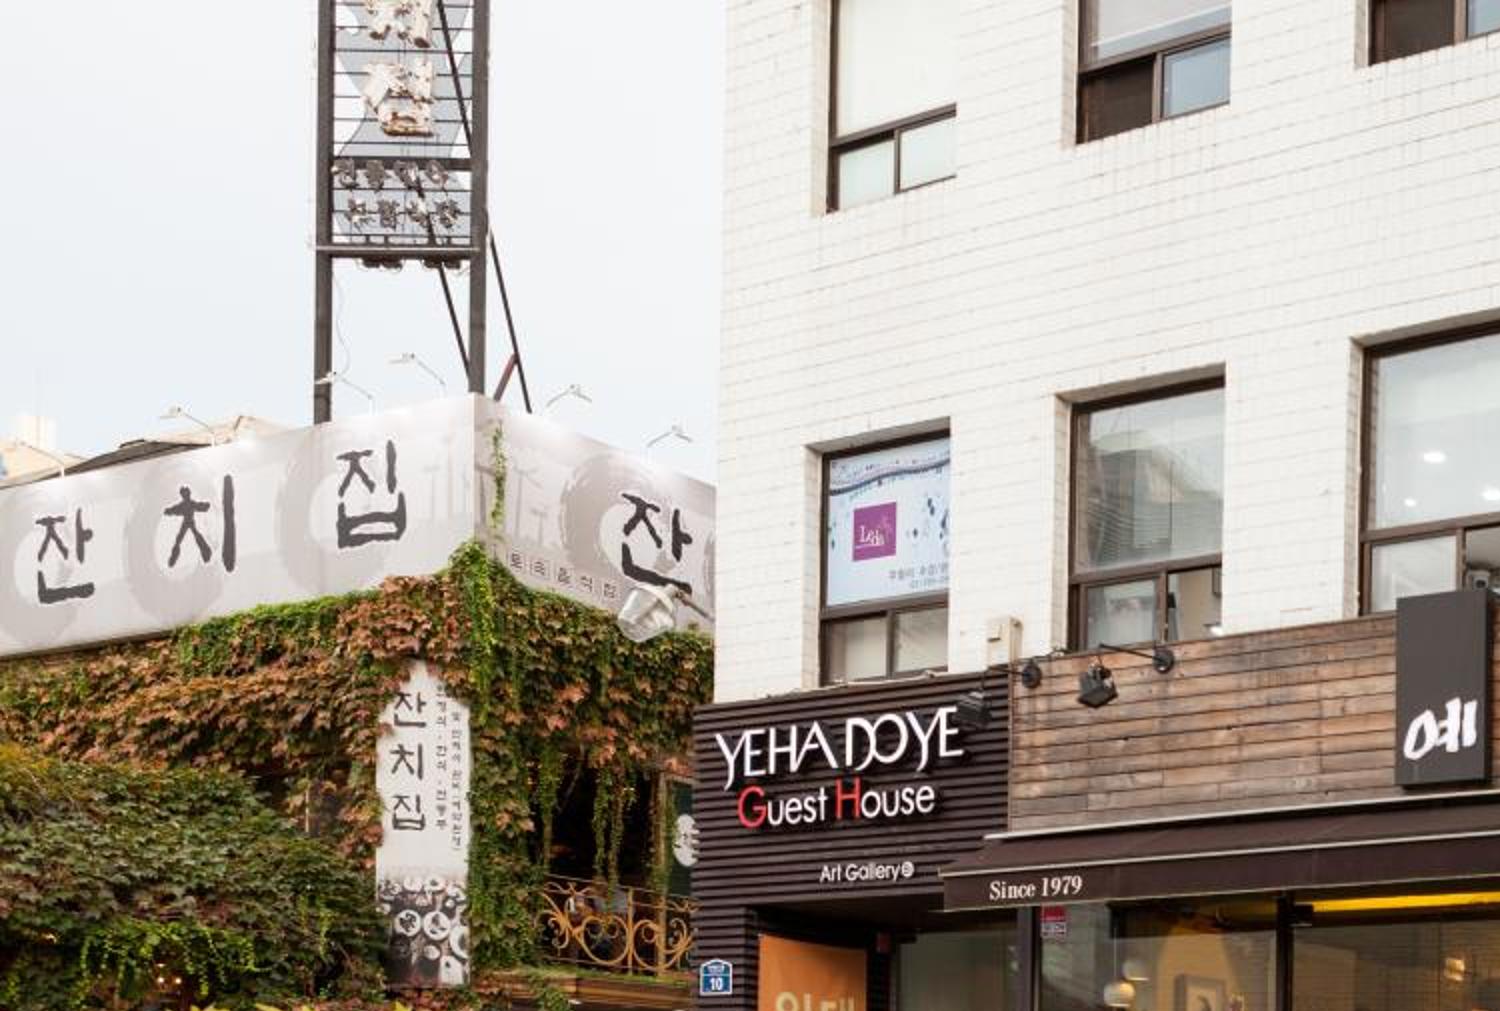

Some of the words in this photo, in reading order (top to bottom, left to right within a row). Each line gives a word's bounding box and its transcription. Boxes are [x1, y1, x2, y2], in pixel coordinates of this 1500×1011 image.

[35, 439, 408, 604] 잔치집
[389, 691, 427, 832] 잔치집
[715, 720, 838, 791] YEHA
[845, 705, 964, 772] DOYE
[737, 785, 828, 829] Guest
[835, 778, 935, 821] House
[820, 863, 842, 883] Art
[845, 861, 901, 883] Gallery
[989, 879, 1036, 900] Since
[1041, 875, 1083, 897] 1979
[710, 977, 723, 991] 10
